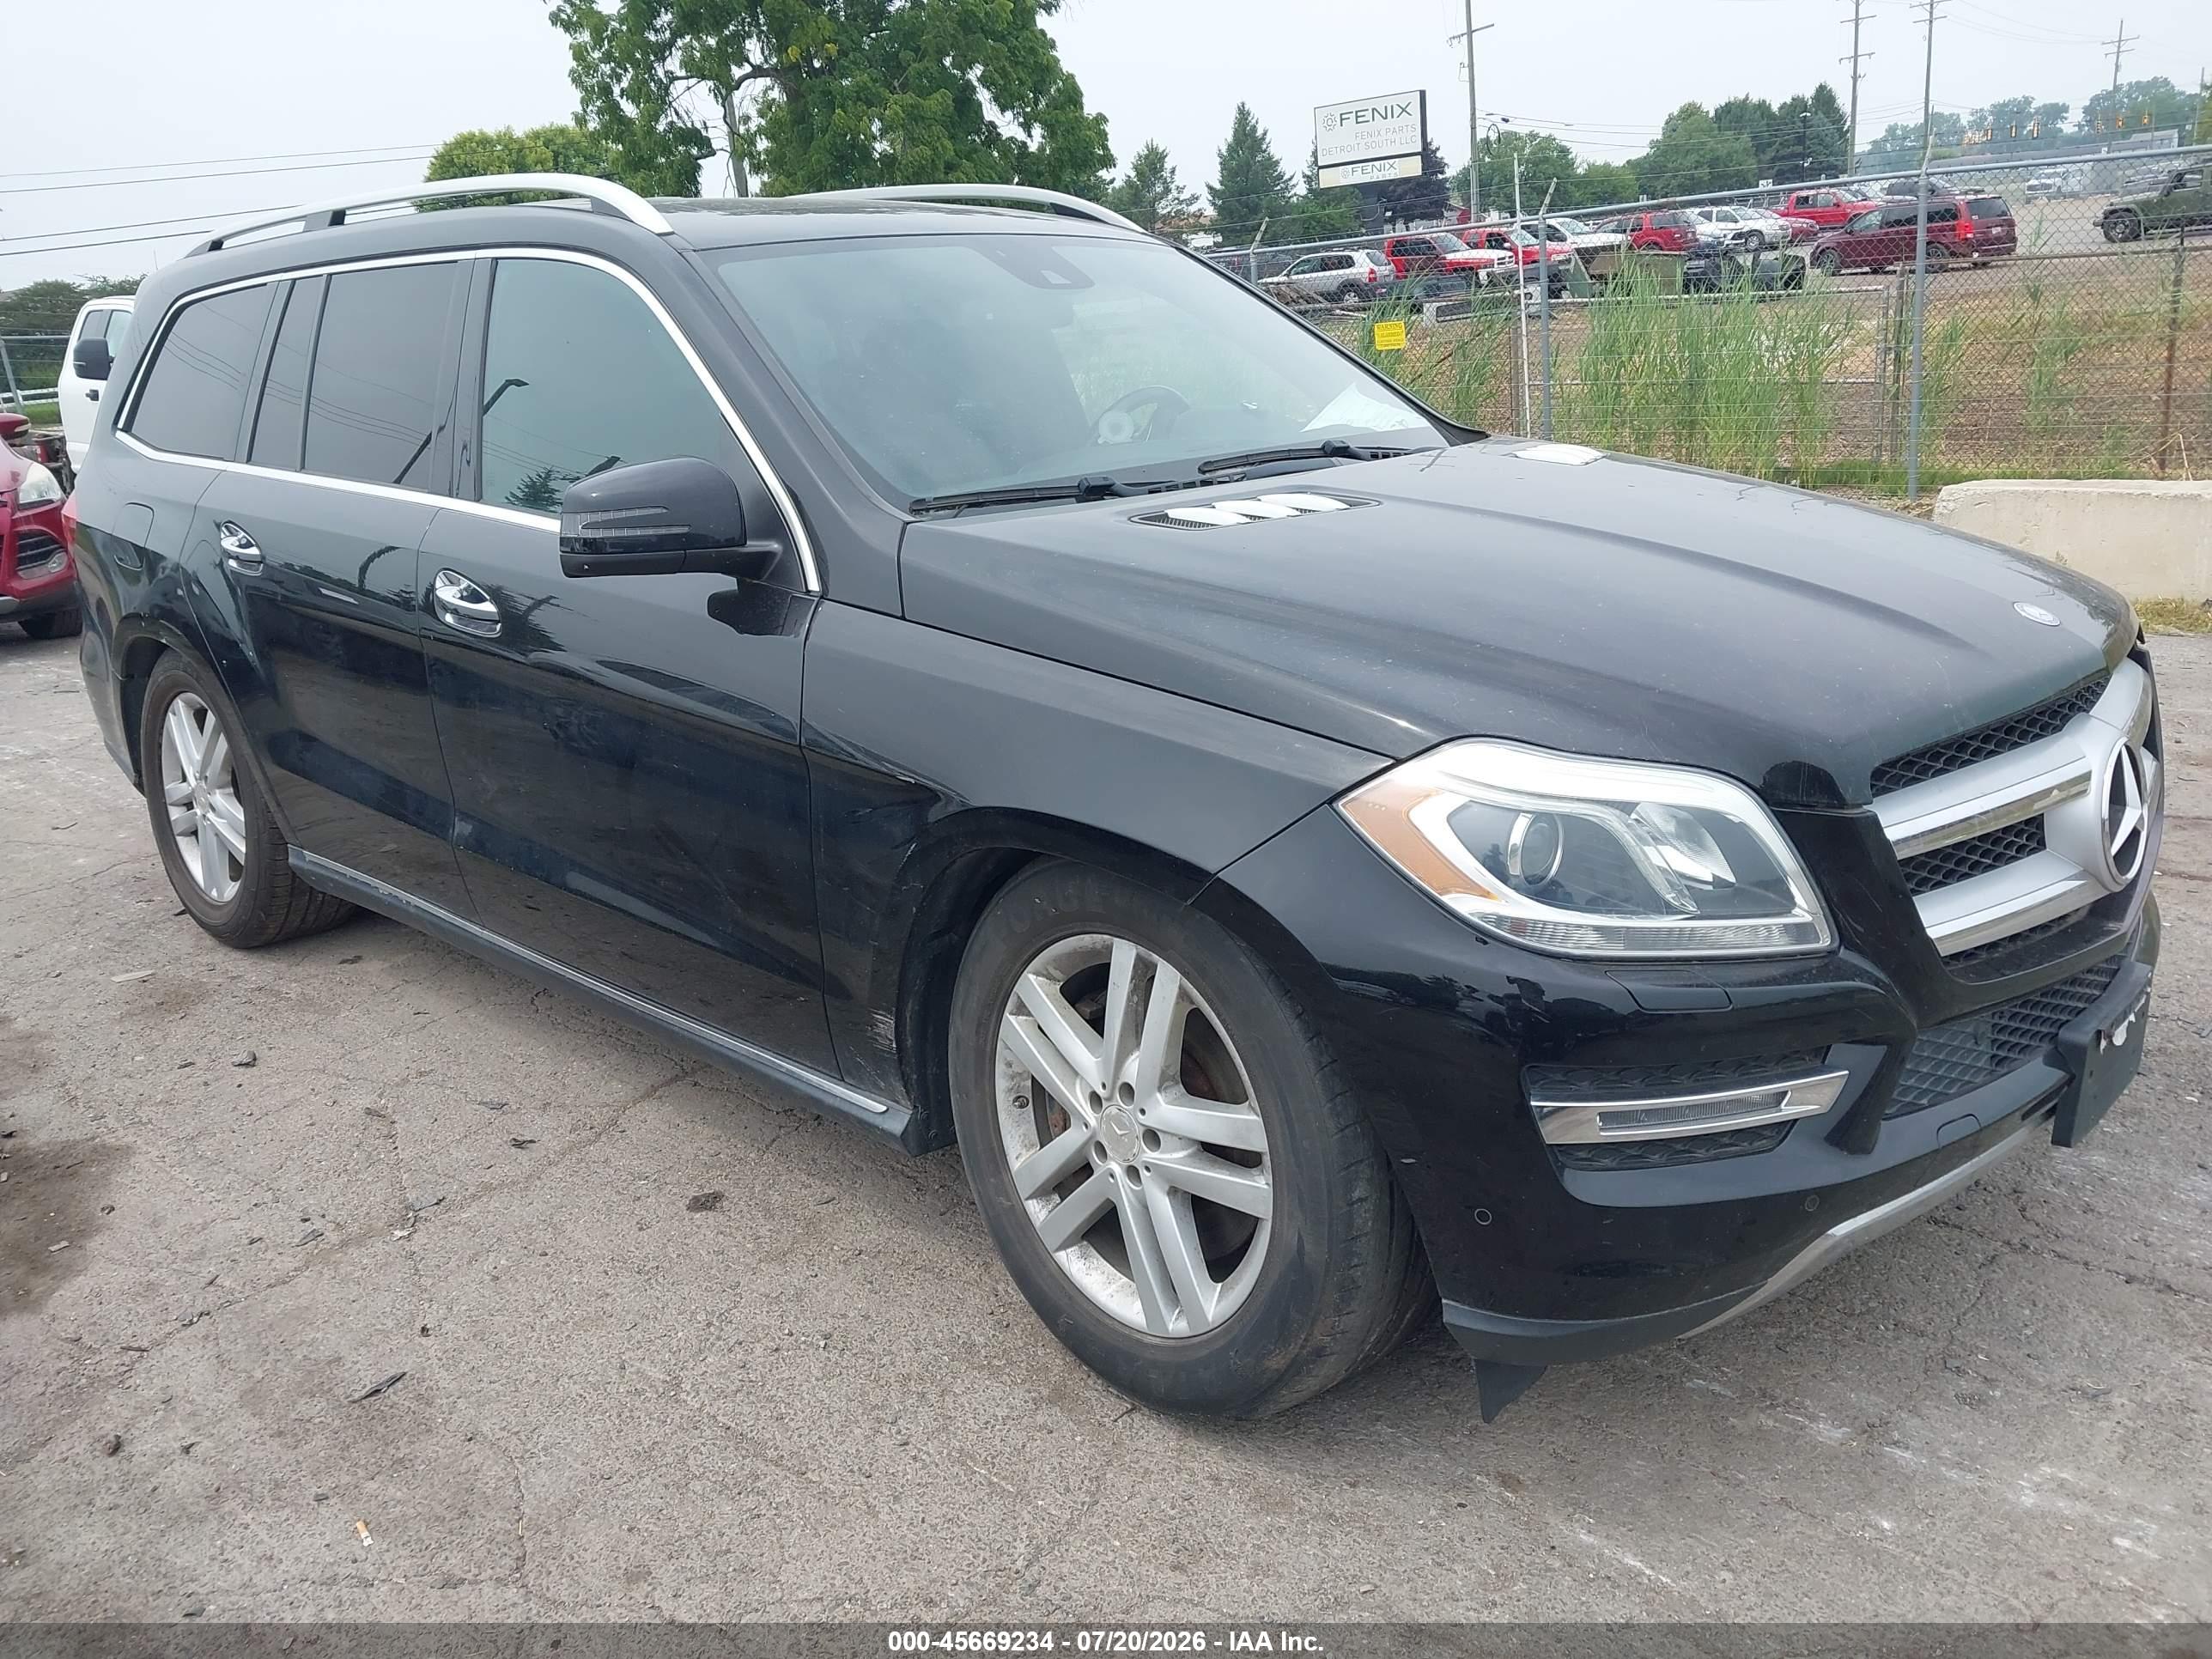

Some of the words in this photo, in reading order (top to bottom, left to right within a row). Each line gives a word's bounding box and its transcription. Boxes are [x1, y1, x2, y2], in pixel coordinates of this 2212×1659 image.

[1340, 101, 1413, 127] FENIX
[1355, 129, 1382, 141] FENIX
[1385, 124, 1417, 137] PARTS
[1322, 143, 1361, 157] DETROIT
[1364, 138, 1396, 151] SOUTH
[1400, 135, 1417, 144] LLC
[1351, 161, 1397, 176] FENIX
